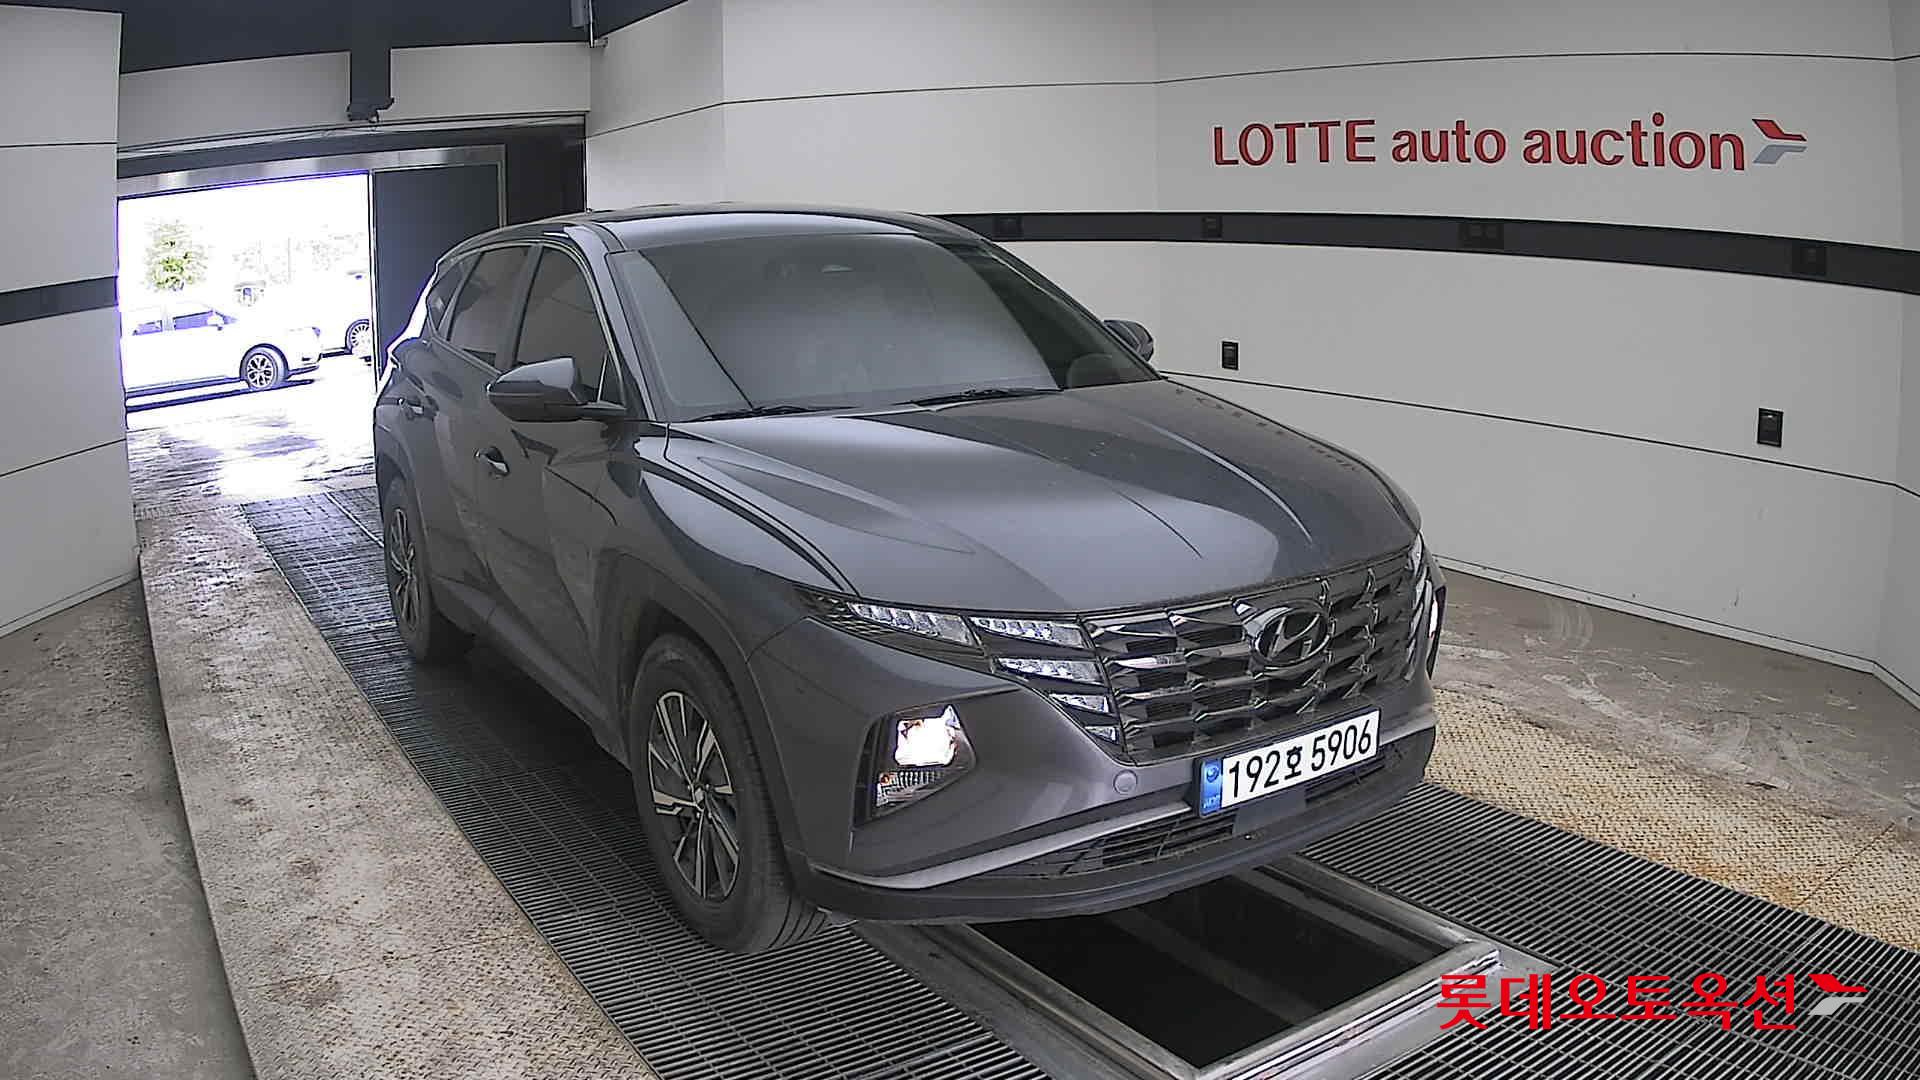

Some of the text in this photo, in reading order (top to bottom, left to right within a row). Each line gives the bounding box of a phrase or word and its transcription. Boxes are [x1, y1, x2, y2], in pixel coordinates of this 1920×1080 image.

[1213, 112, 1746, 171] LOTTE auto auction
[1229, 719, 1372, 798] 192호 5906
